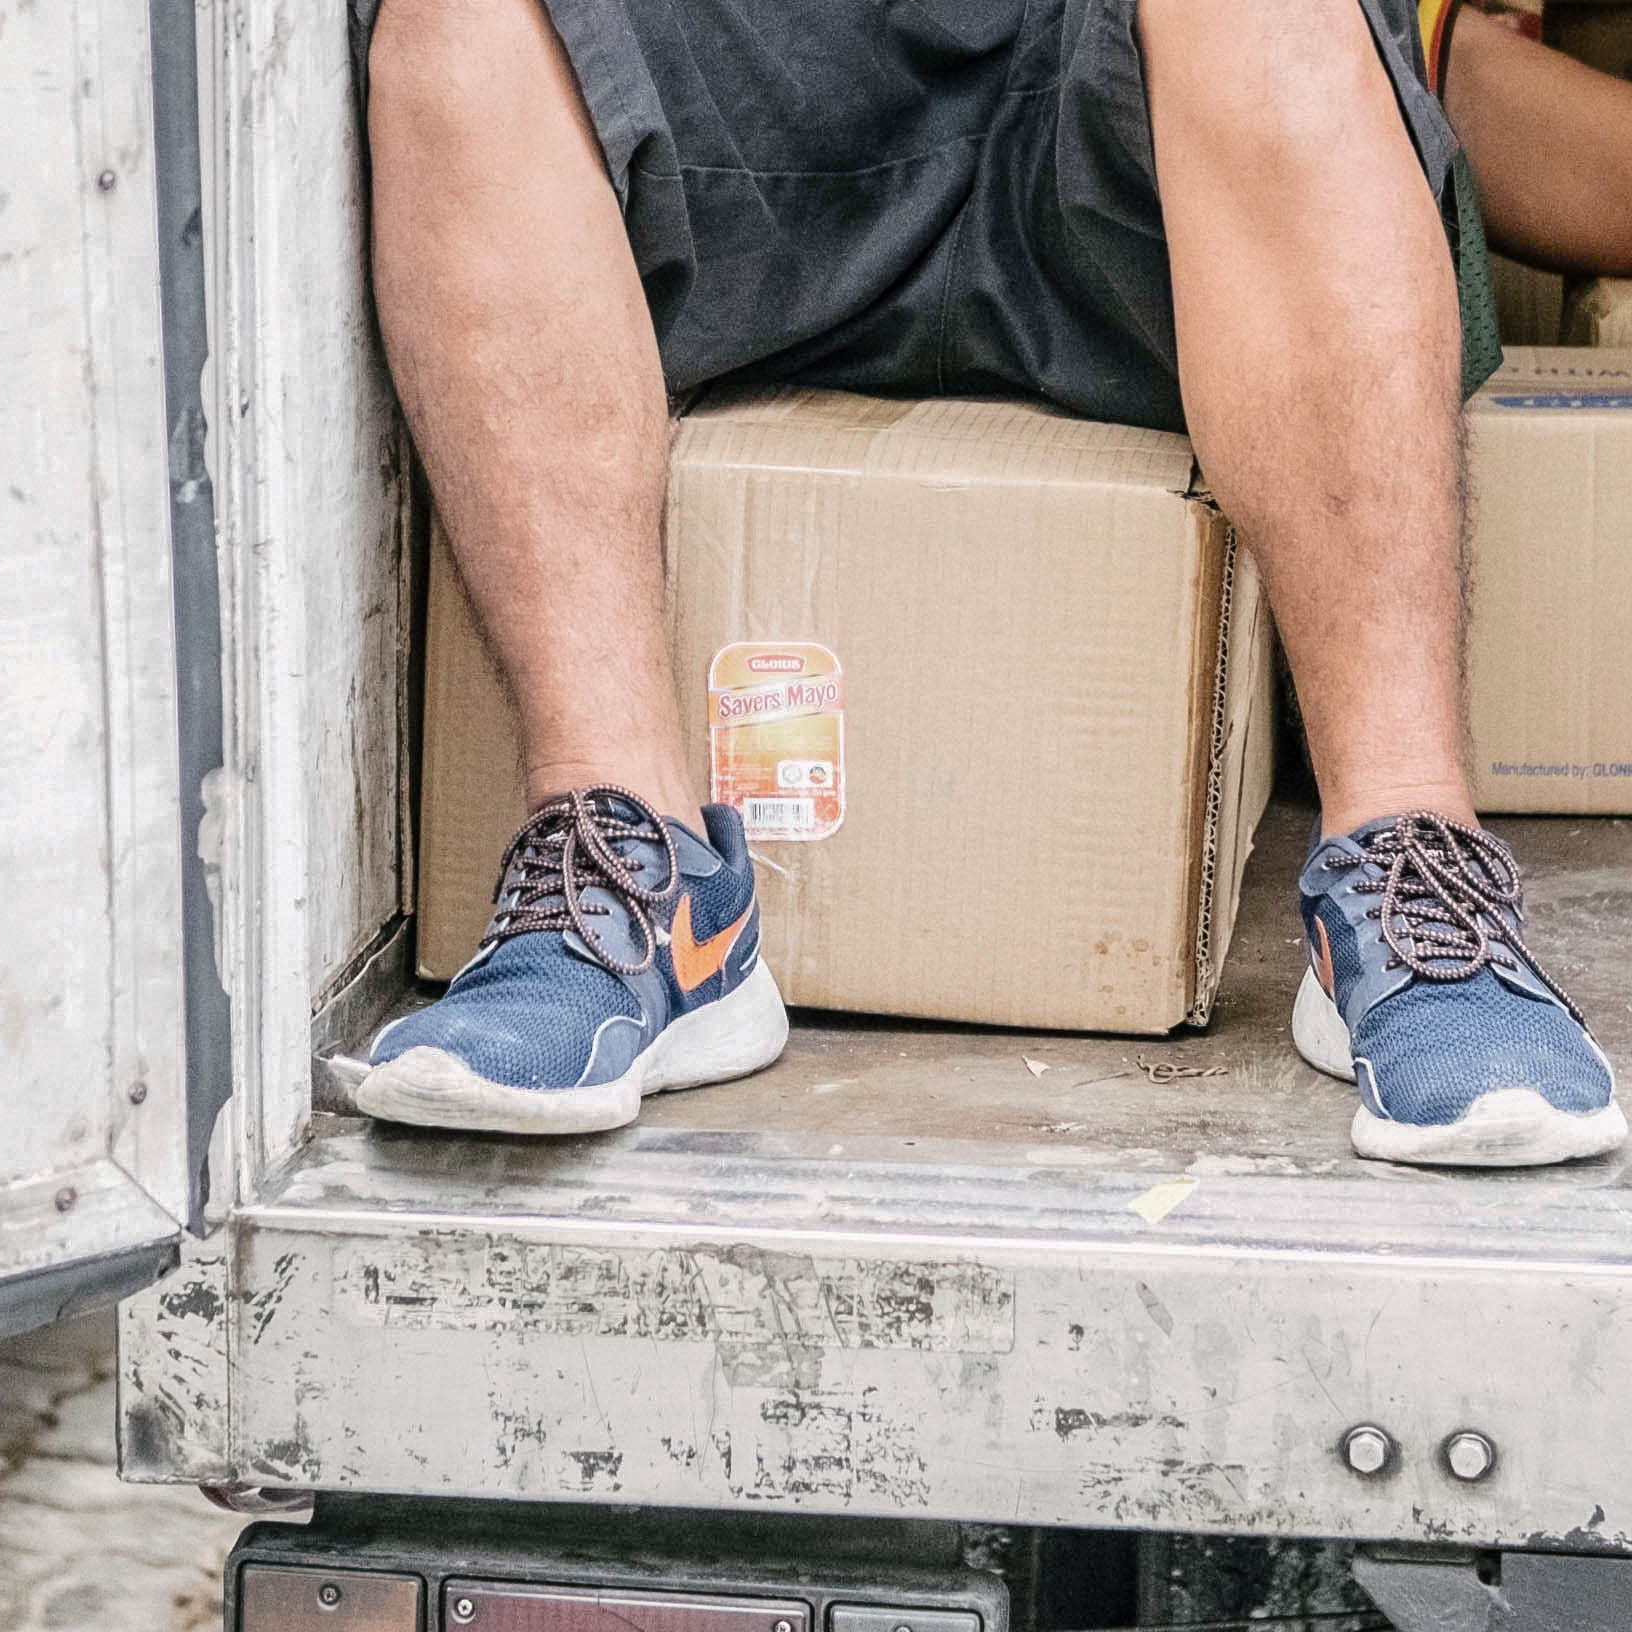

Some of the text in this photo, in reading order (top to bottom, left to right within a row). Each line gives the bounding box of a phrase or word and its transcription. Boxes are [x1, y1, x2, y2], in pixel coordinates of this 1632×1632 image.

[720, 682, 837, 718] Savers Mayo
[1491, 761, 1569, 777] Manufactured
